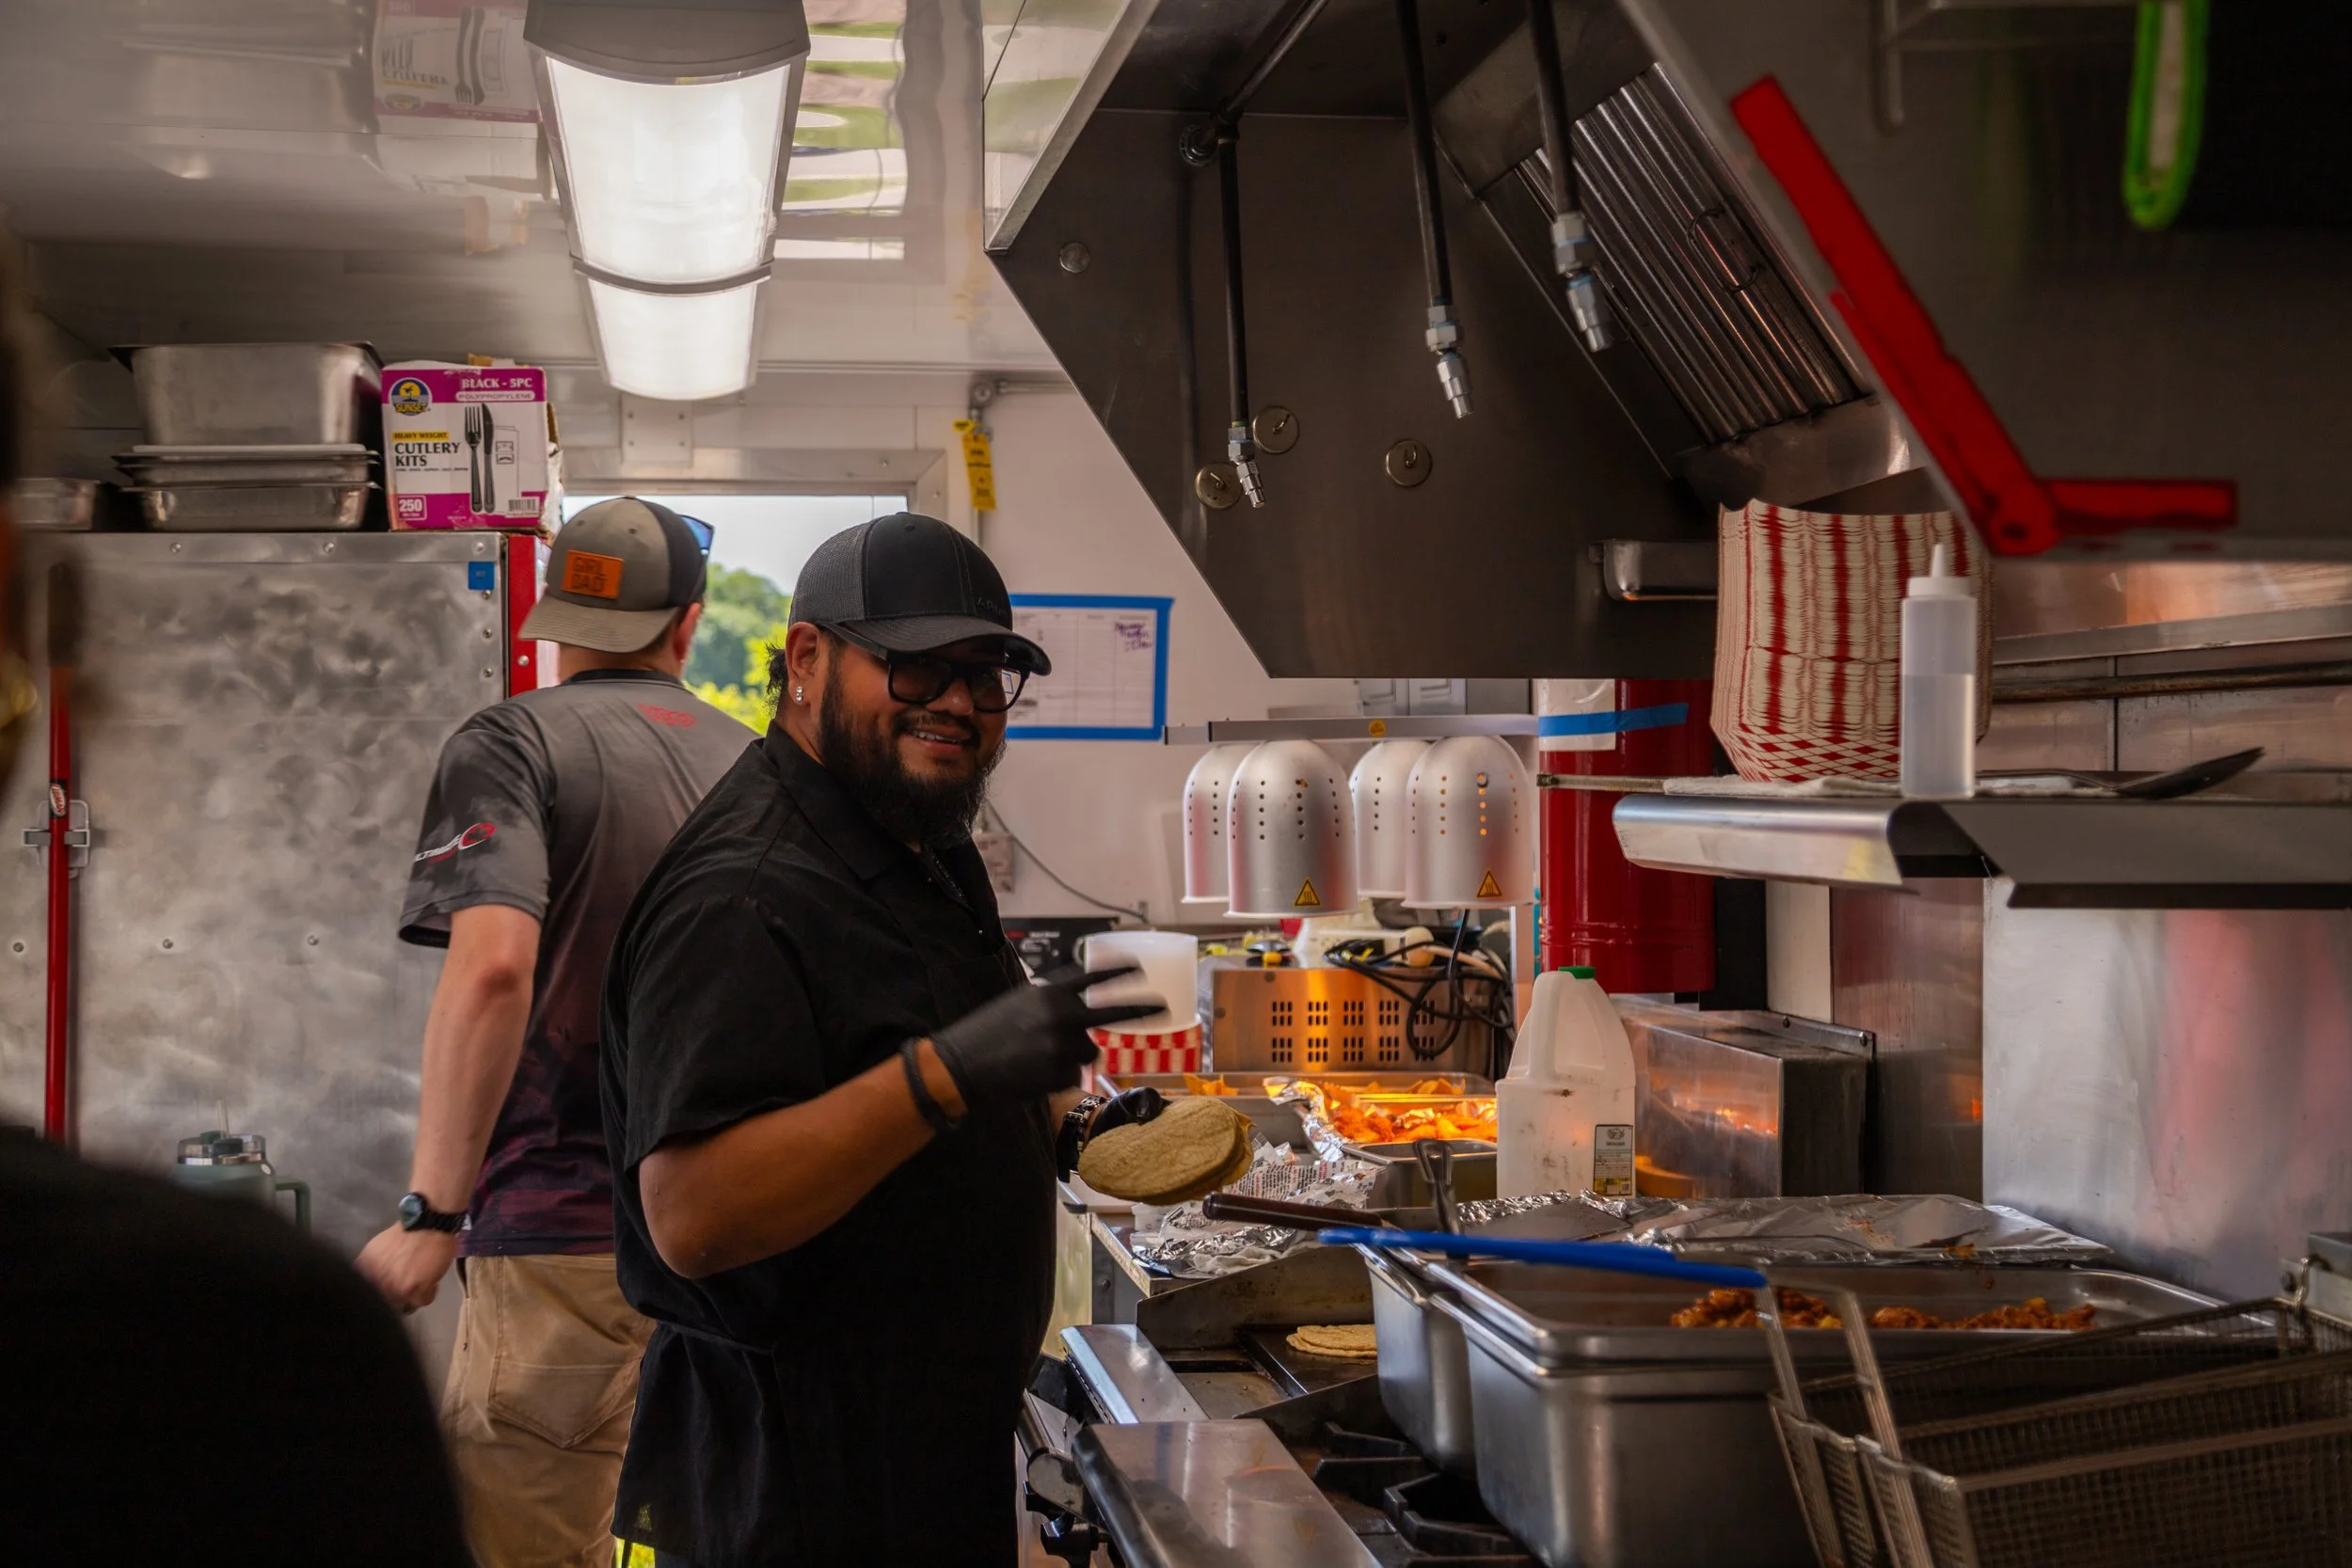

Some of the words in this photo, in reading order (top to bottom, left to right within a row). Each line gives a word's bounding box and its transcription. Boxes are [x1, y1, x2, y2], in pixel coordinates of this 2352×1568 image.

[462, 378, 500, 388] BLACK
[510, 377, 532, 388] 5PC
[394, 403, 428, 414] SUNSET
[394, 442, 461, 454] CUTLERY
[395, 454, 428, 467] KITS
[399, 499, 423, 513] 250
[573, 557, 606, 576] GIRL
[570, 573, 607, 592] DAD
